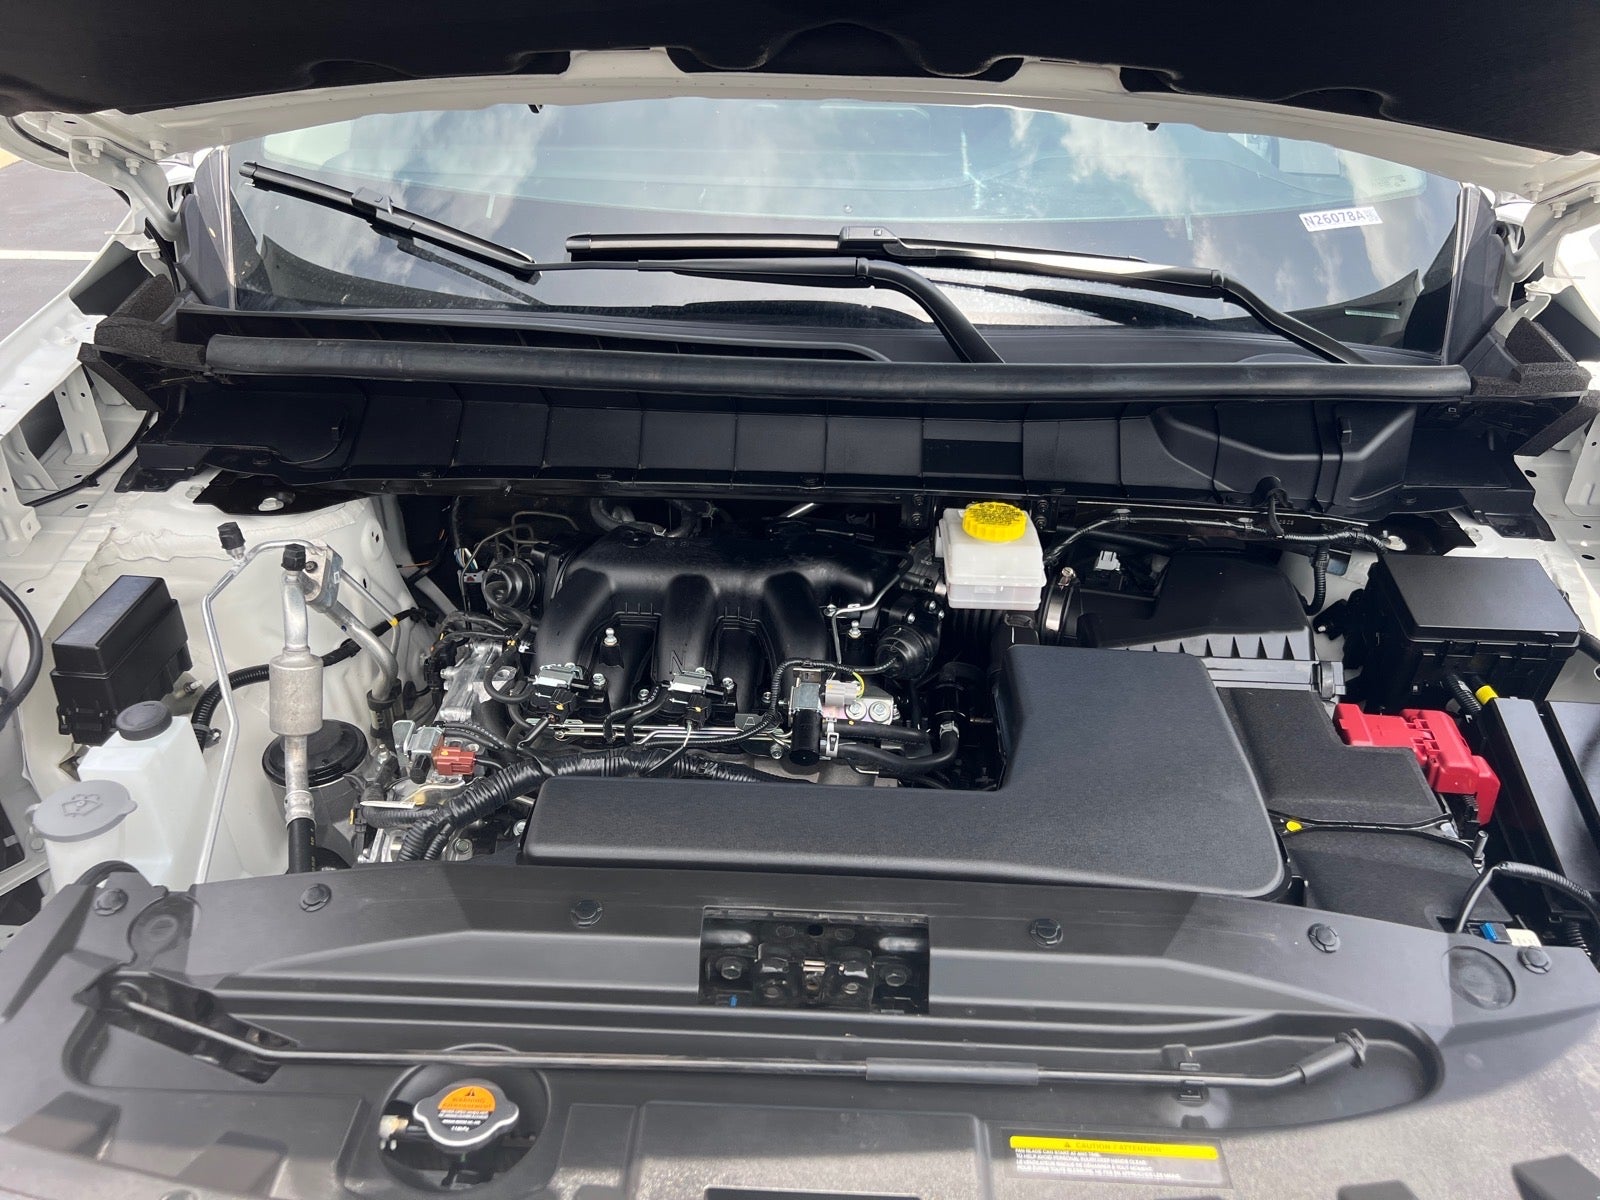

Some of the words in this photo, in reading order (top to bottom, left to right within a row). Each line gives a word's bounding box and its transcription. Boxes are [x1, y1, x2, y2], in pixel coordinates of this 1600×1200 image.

[1303, 210, 1366, 227] N26078A
[1076, 1142, 1111, 1150] CAUTION
[1119, 1144, 1162, 1153] ATTENTION
